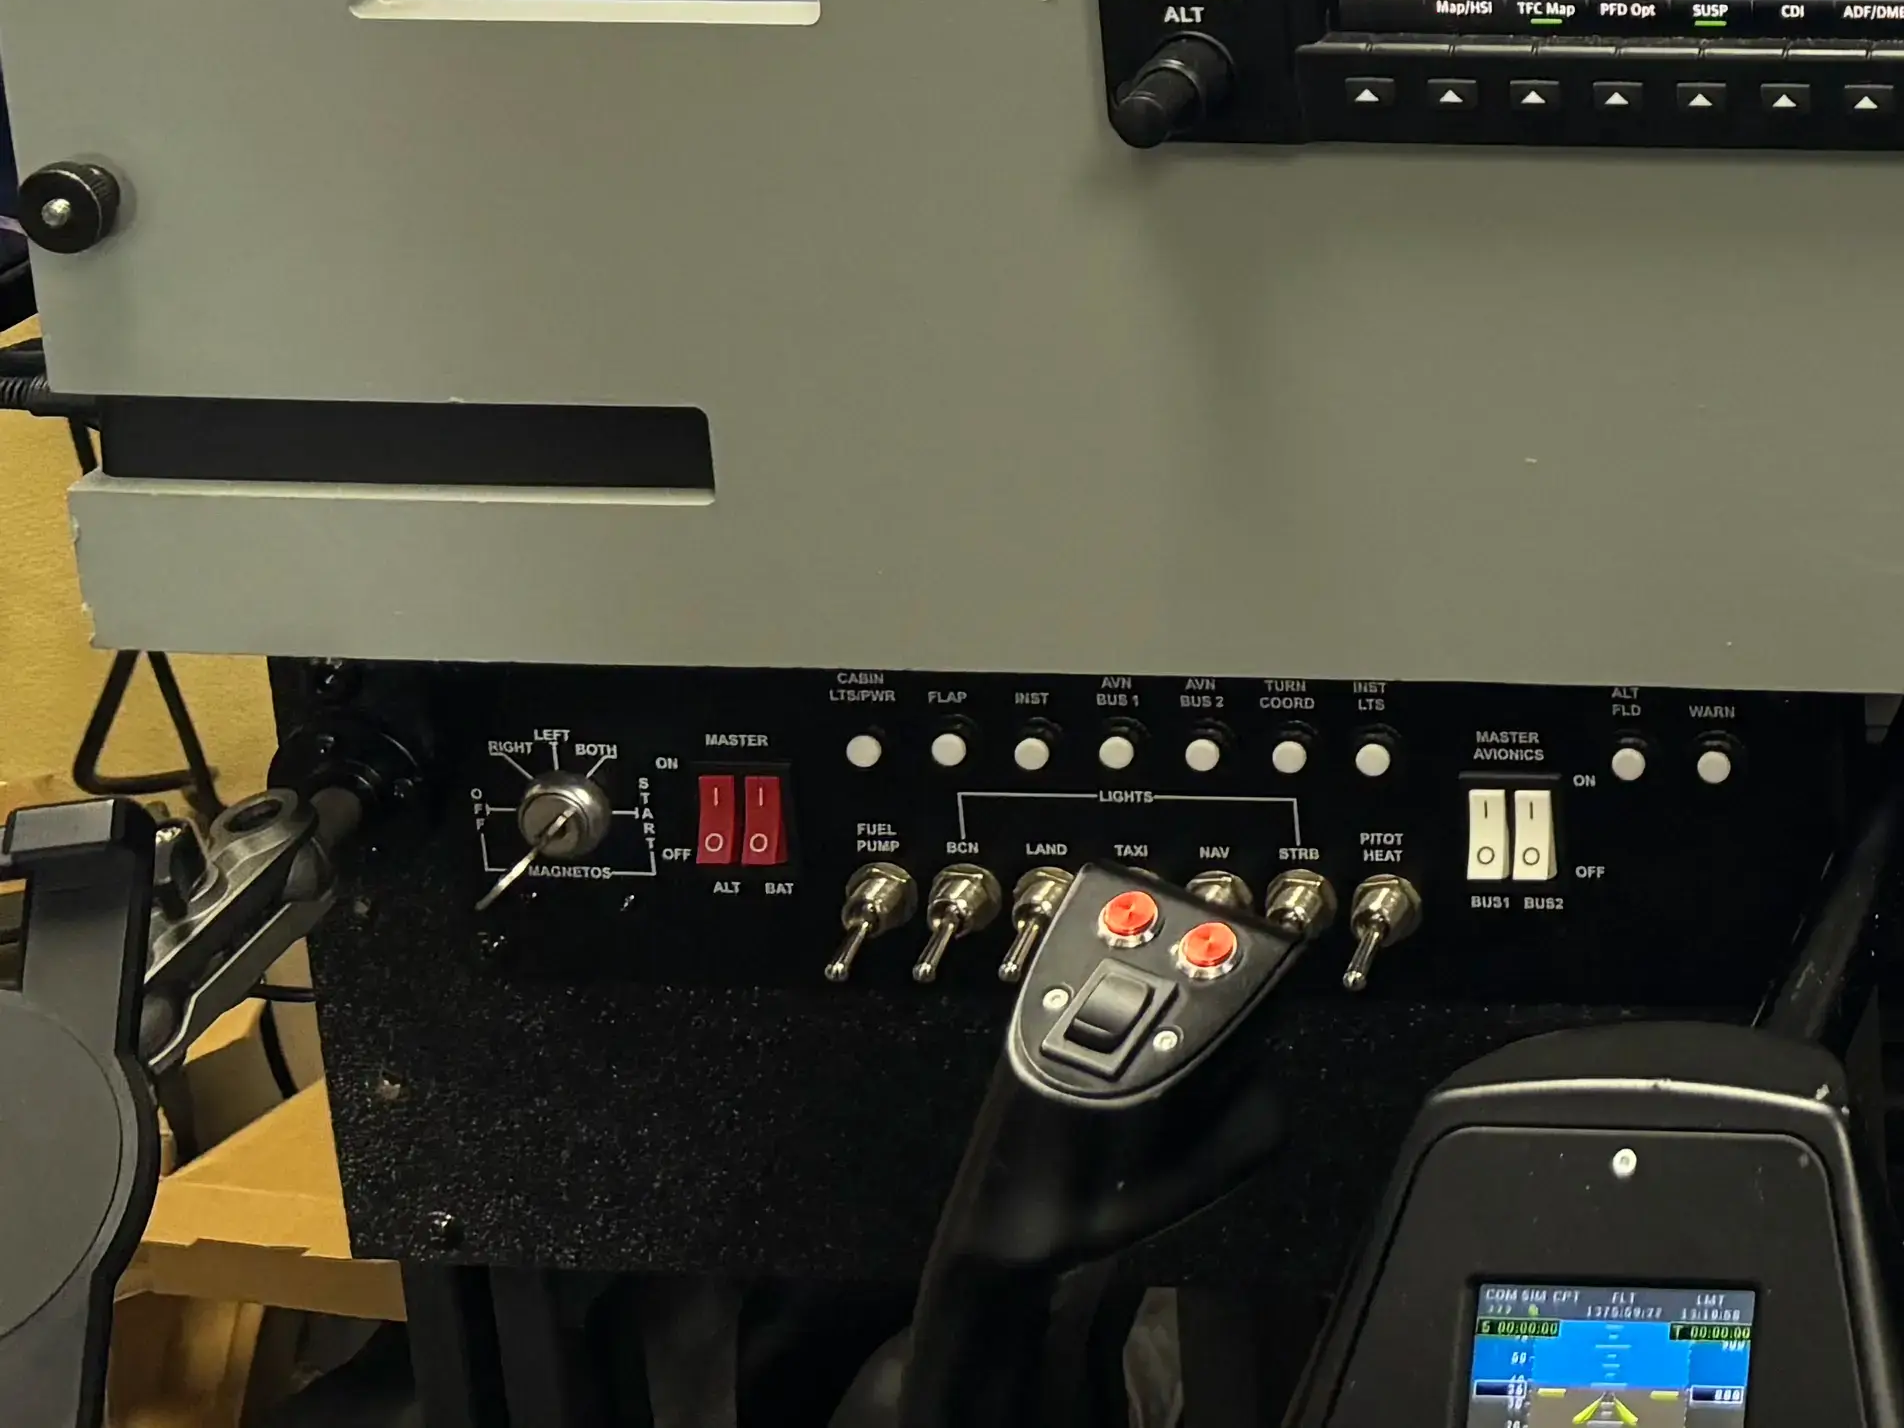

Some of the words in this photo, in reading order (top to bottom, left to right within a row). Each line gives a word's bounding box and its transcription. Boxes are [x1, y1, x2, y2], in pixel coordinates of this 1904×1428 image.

[1164, 6, 1204, 23] ALT
[705, 734, 768, 747] MASTER
[1476, 731, 1539, 745] MASTER
[1474, 748, 1544, 762] AVIONICS
[1100, 790, 1153, 804] LIGHTS
[857, 823, 896, 836] FUEL
[857, 840, 899, 852] PUMP
[1200, 846, 1229, 859] NAV
[528, 865, 612, 879] MAGNETOS
[713, 882, 740, 894] ALT
[765, 882, 794, 895] BAT
[1471, 896, 1510, 910] BUS1
